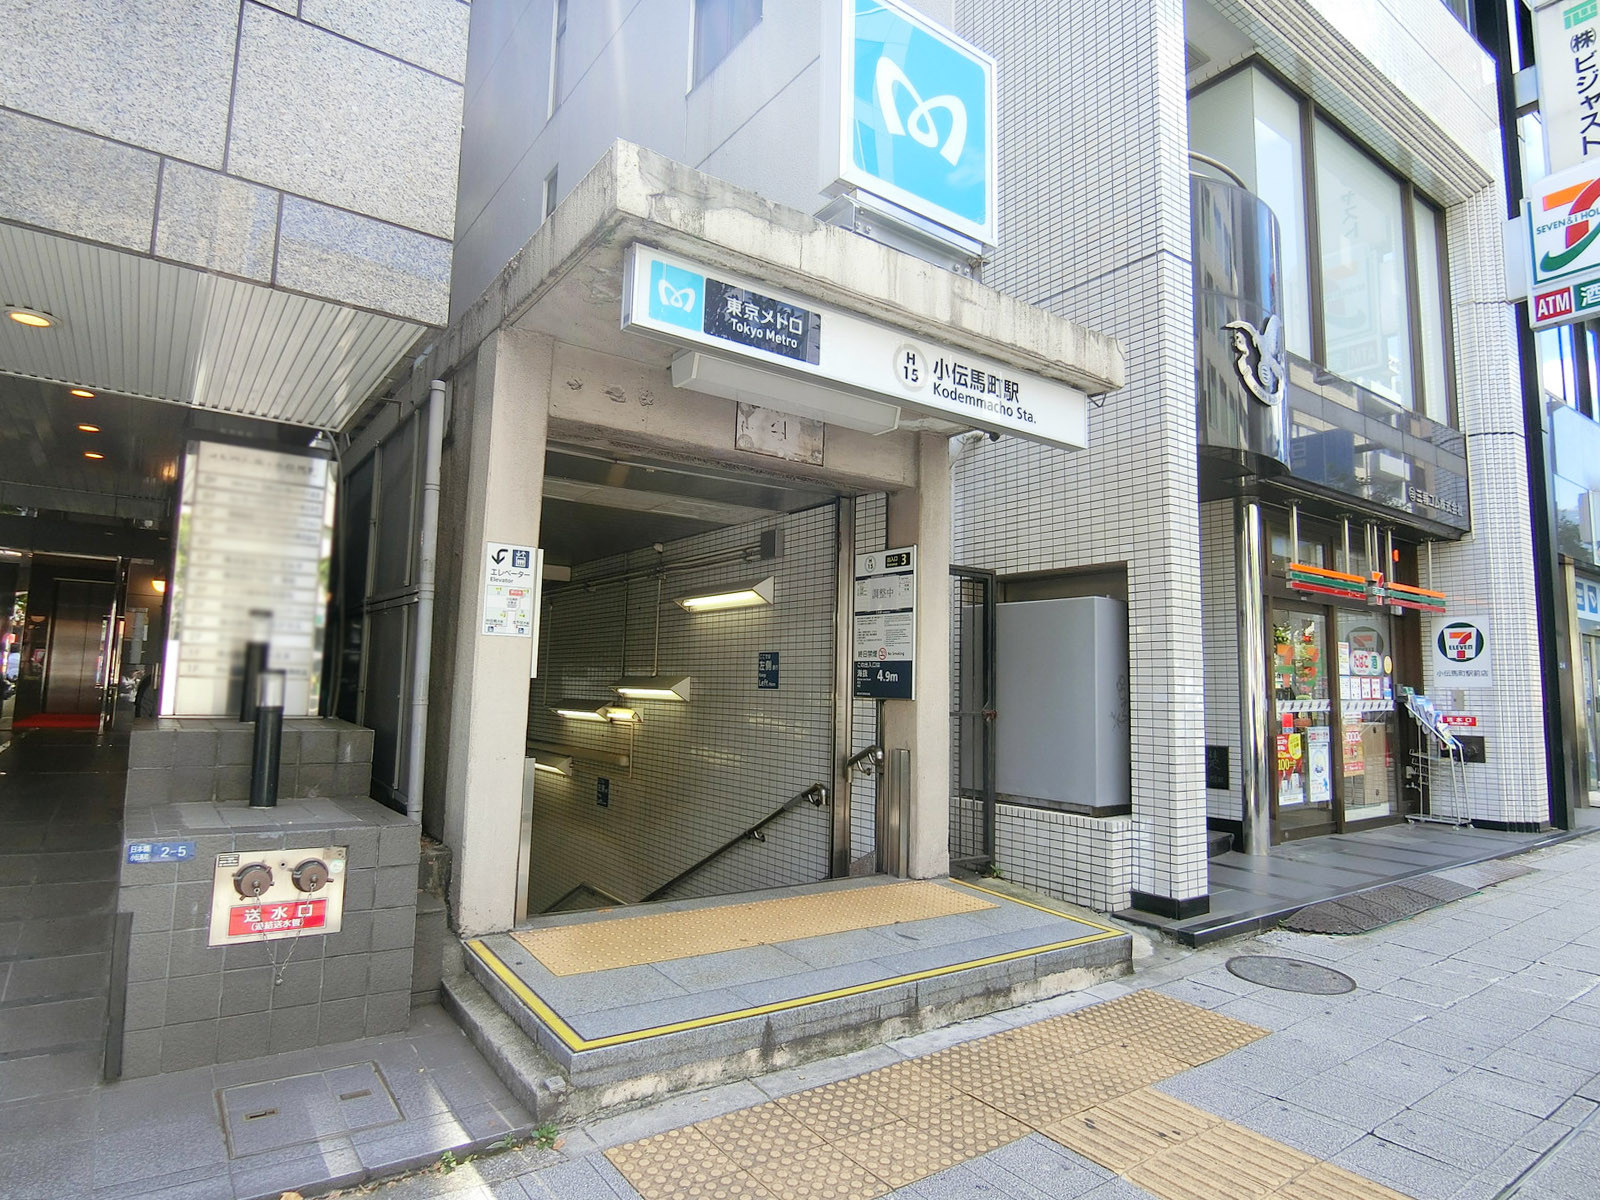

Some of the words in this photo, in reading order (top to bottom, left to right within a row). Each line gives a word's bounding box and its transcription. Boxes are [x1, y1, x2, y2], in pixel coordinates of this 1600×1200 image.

[1537, 291, 1571, 318] ATM
[726, 297, 803, 335] 東京メトロ
[729, 317, 764, 339] Tokyo
[765, 328, 798, 349] Metro
[906, 351, 916, 366] H
[903, 365, 919, 383] 15
[933, 358, 1020, 404] 小伝馬町駅
[933, 382, 1014, 417] Kodemmacho
[1016, 406, 1037, 425] Sta.
[900, 553, 907, 566] 3
[489, 576, 514, 584] Elevator
[490, 568, 531, 579] エレベーター
[876, 669, 899, 682] 4.9m
[160, 845, 187, 858] 2-5
[243, 904, 313, 923] 送水口
